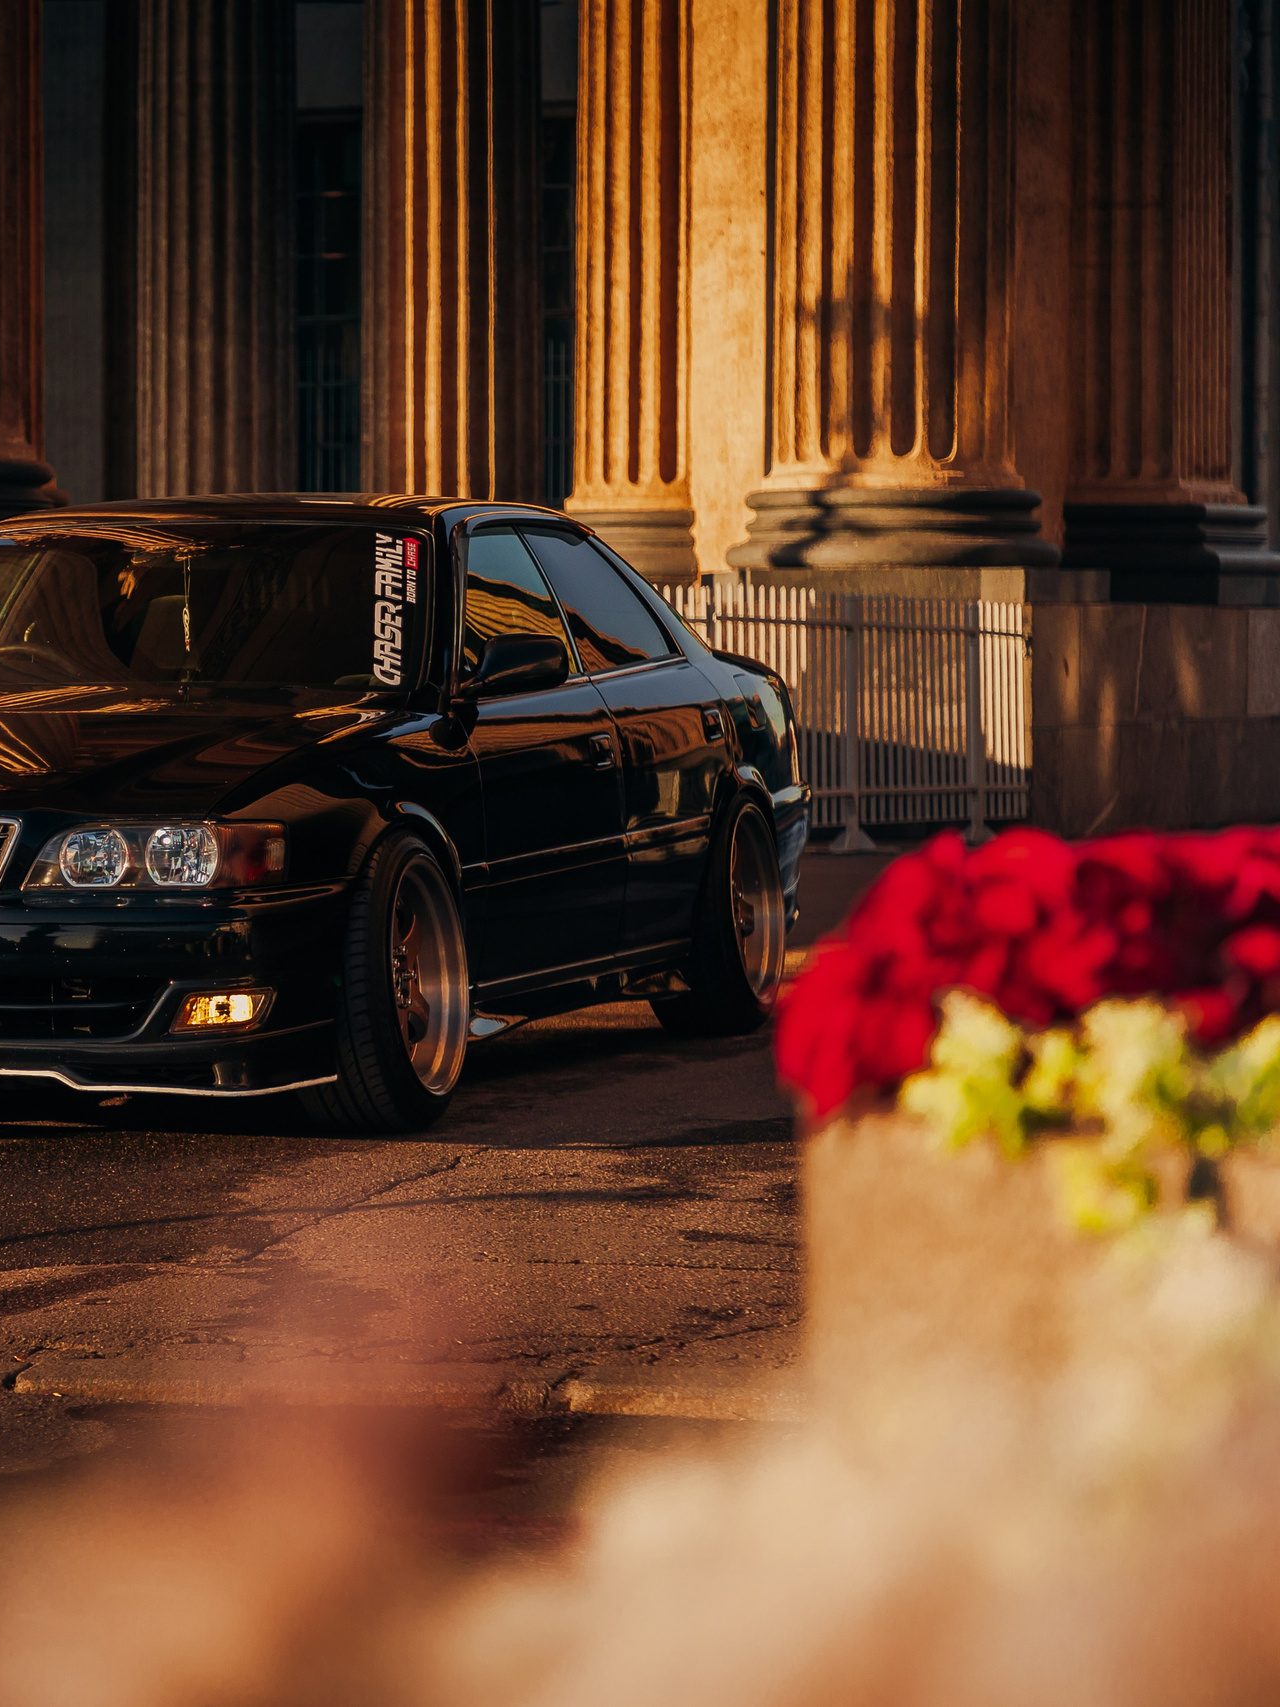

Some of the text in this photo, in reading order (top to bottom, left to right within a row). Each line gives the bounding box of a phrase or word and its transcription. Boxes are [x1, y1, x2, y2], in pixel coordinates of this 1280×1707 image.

[406, 542, 417, 604] BORN TO CHASE
[373, 600, 403, 686] CHASER
